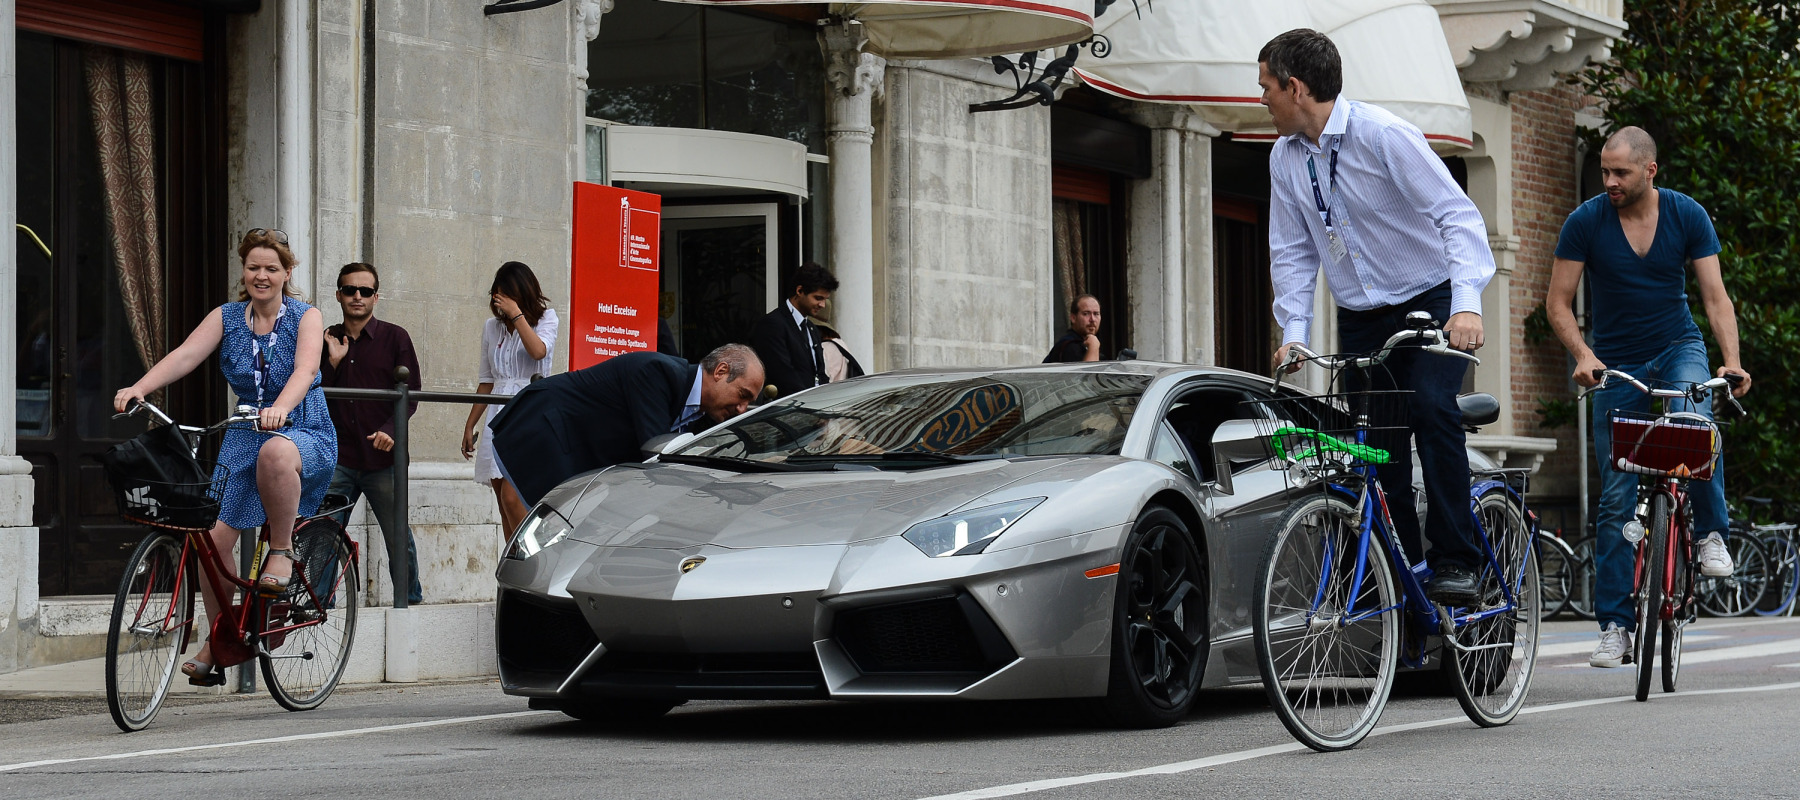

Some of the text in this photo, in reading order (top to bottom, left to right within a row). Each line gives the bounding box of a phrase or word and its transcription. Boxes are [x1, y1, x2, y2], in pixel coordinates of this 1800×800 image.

[598, 303, 637, 316] Hotel Excelsior
[626, 328, 639, 337] Lounge
[586, 335, 607, 344] Fondazione
[628, 339, 647, 348] Spettacolo
